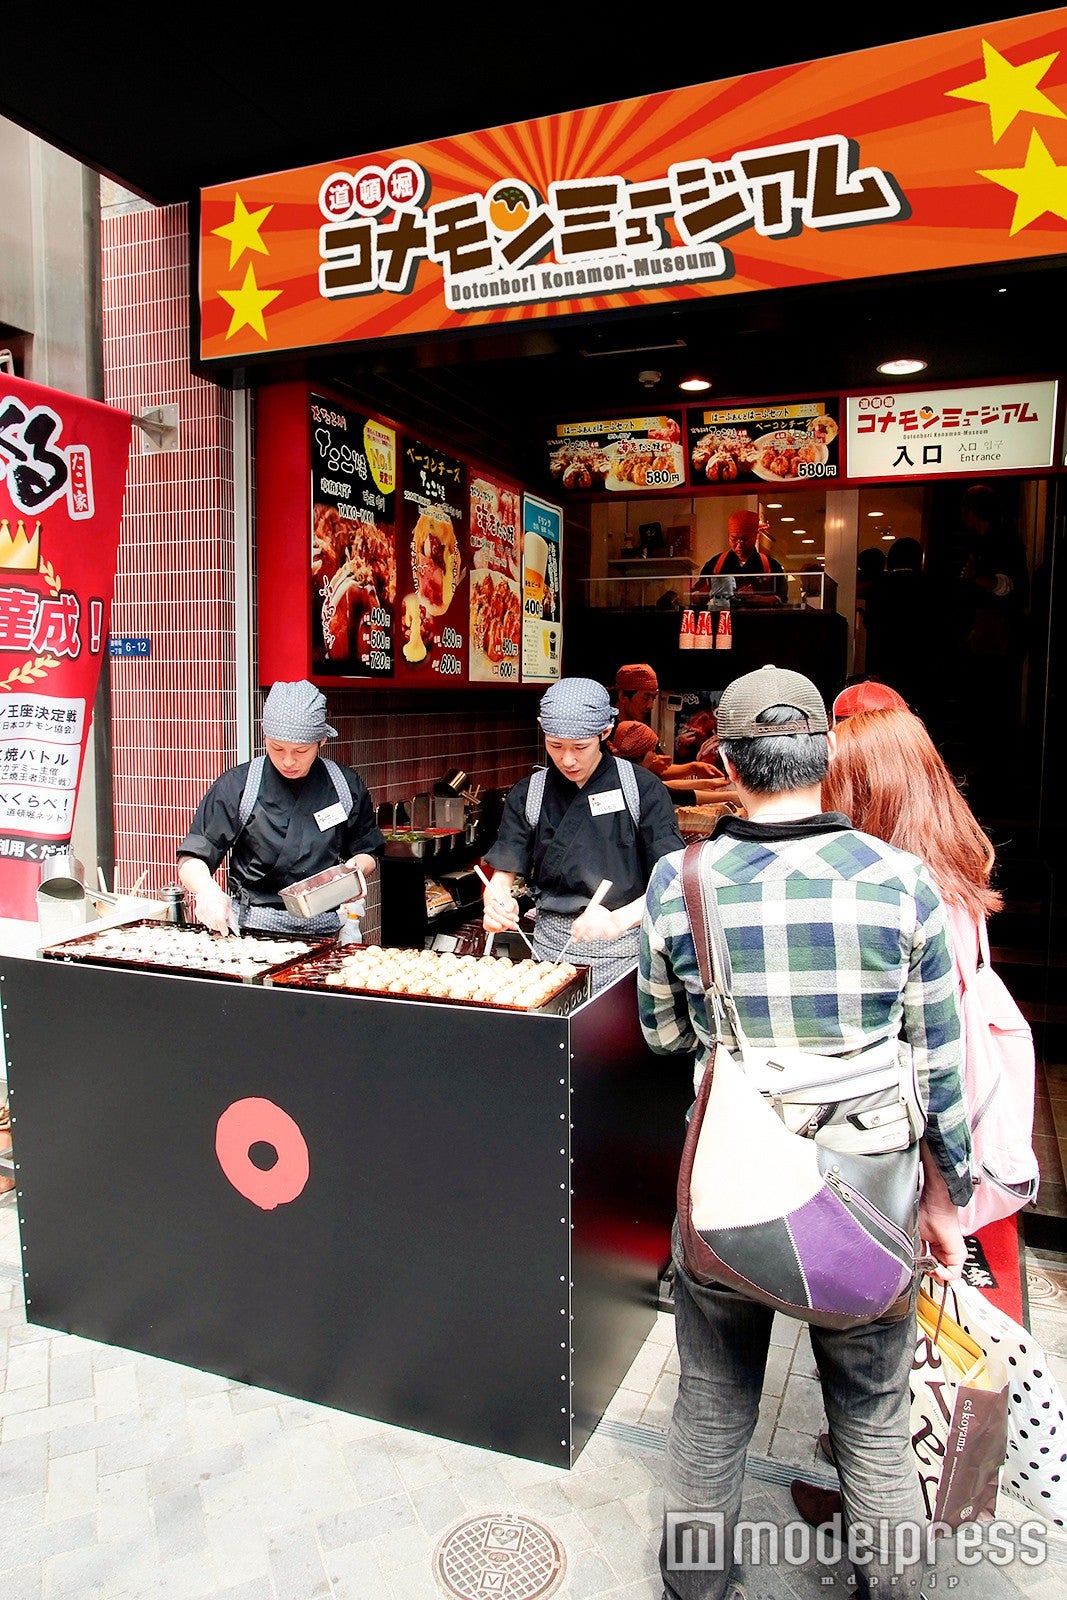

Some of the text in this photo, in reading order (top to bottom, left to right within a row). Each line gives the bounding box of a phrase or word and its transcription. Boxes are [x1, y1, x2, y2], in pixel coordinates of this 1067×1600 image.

[325, 168, 418, 214] 道頓堀
[324, 143, 891, 289] コナモンミュージアム
[541, 250, 717, 290] Konamon-Museum
[857, 402, 1039, 434] コナモンミュージアム
[892, 444, 943, 468] 入口
[958, 442, 977, 452] 入口
[960, 453, 1001, 463] Entrance
[370, 447, 393, 471] No.1
[406, 447, 461, 483] ベーコンチーズ
[799, 463, 837, 477] 580円
[70, 452, 88, 512] たこ家
[646, 471, 680, 485] 580円
[371, 606, 391, 628] 400円
[125, 641, 147, 652] 6-12
[371, 629, 391, 649] 500円
[370, 650, 391, 670] 720円
[0, 748, 69, 766] 焼バトル
[0, 763, 59, 776] カデミー主催
[956, 1412, 976, 1453] koyama
